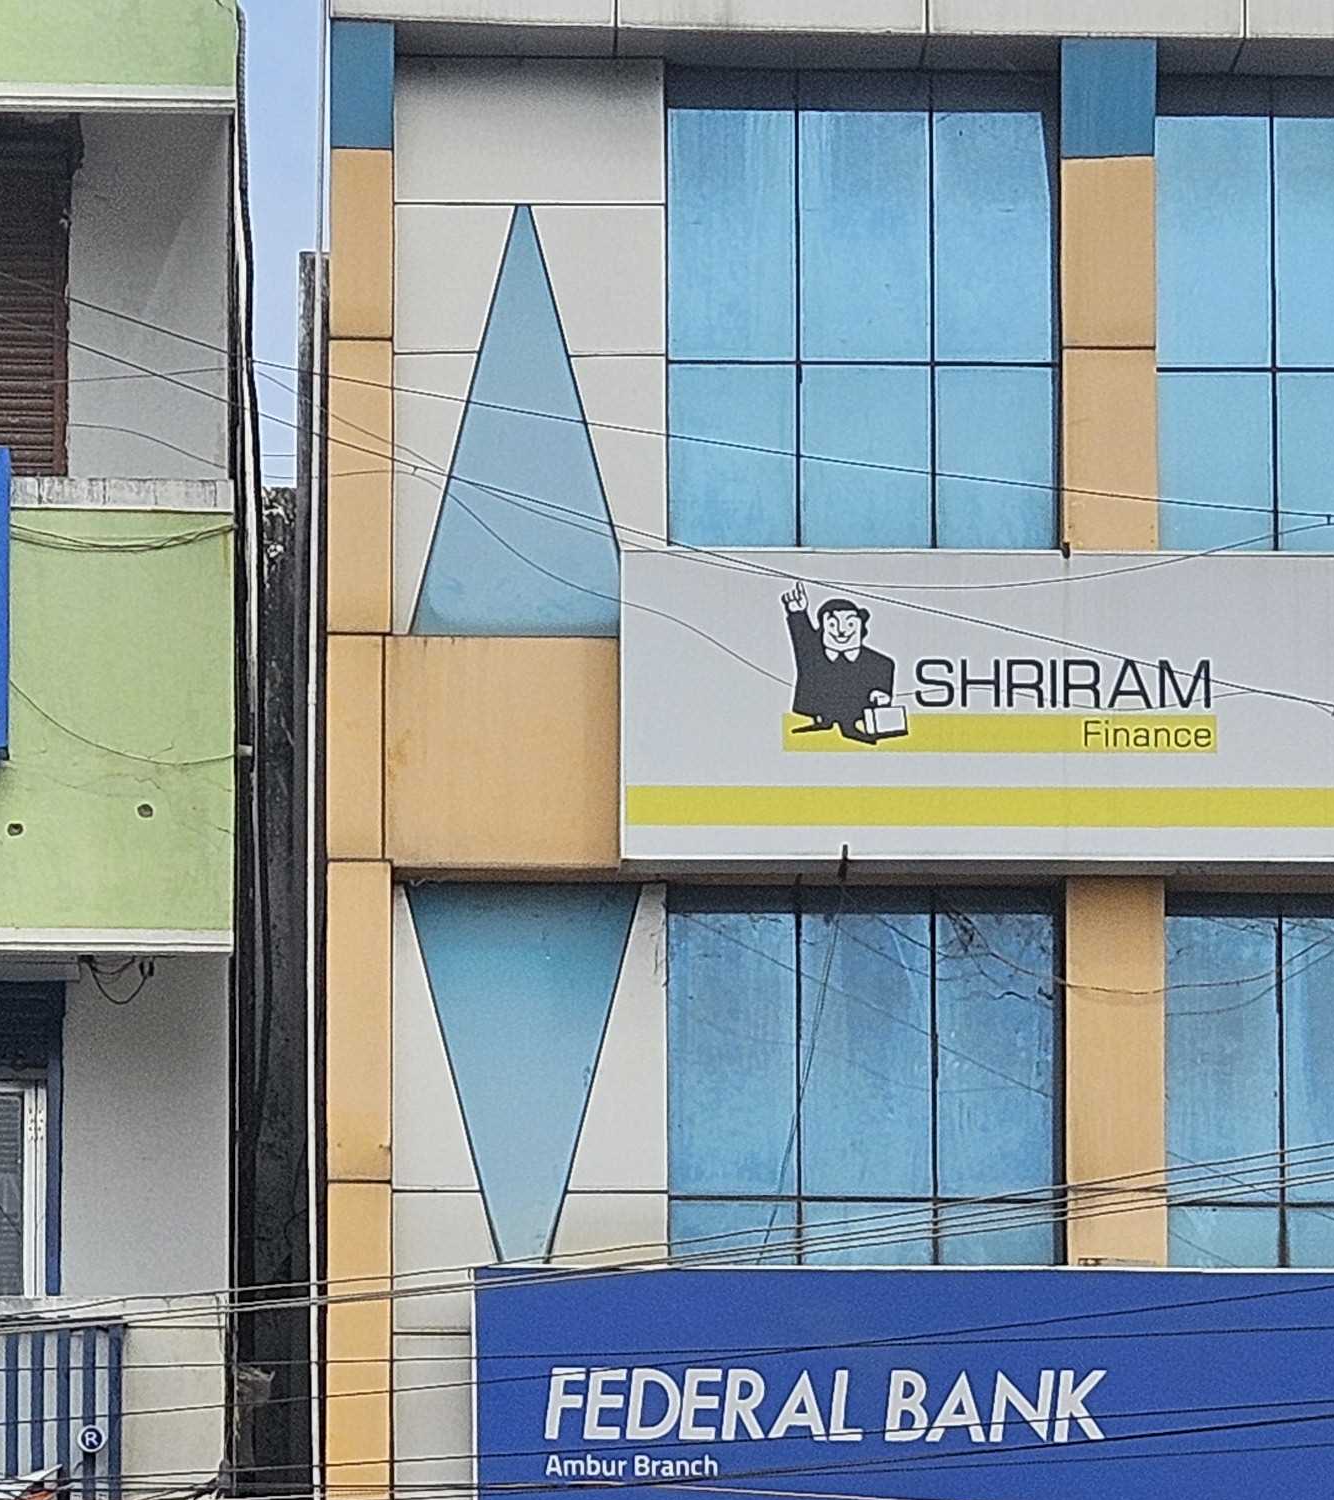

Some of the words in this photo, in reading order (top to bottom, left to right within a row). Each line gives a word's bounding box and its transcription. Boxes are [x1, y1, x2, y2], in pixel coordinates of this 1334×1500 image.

[915, 659, 1212, 708] SHRIRAM
[1084, 721, 1212, 747] Finance
[545, 1367, 864, 1442] FEDERAL
[885, 1369, 1106, 1444] BANK
[546, 1455, 626, 1477] Ambur
[635, 1455, 718, 1478] Branch
